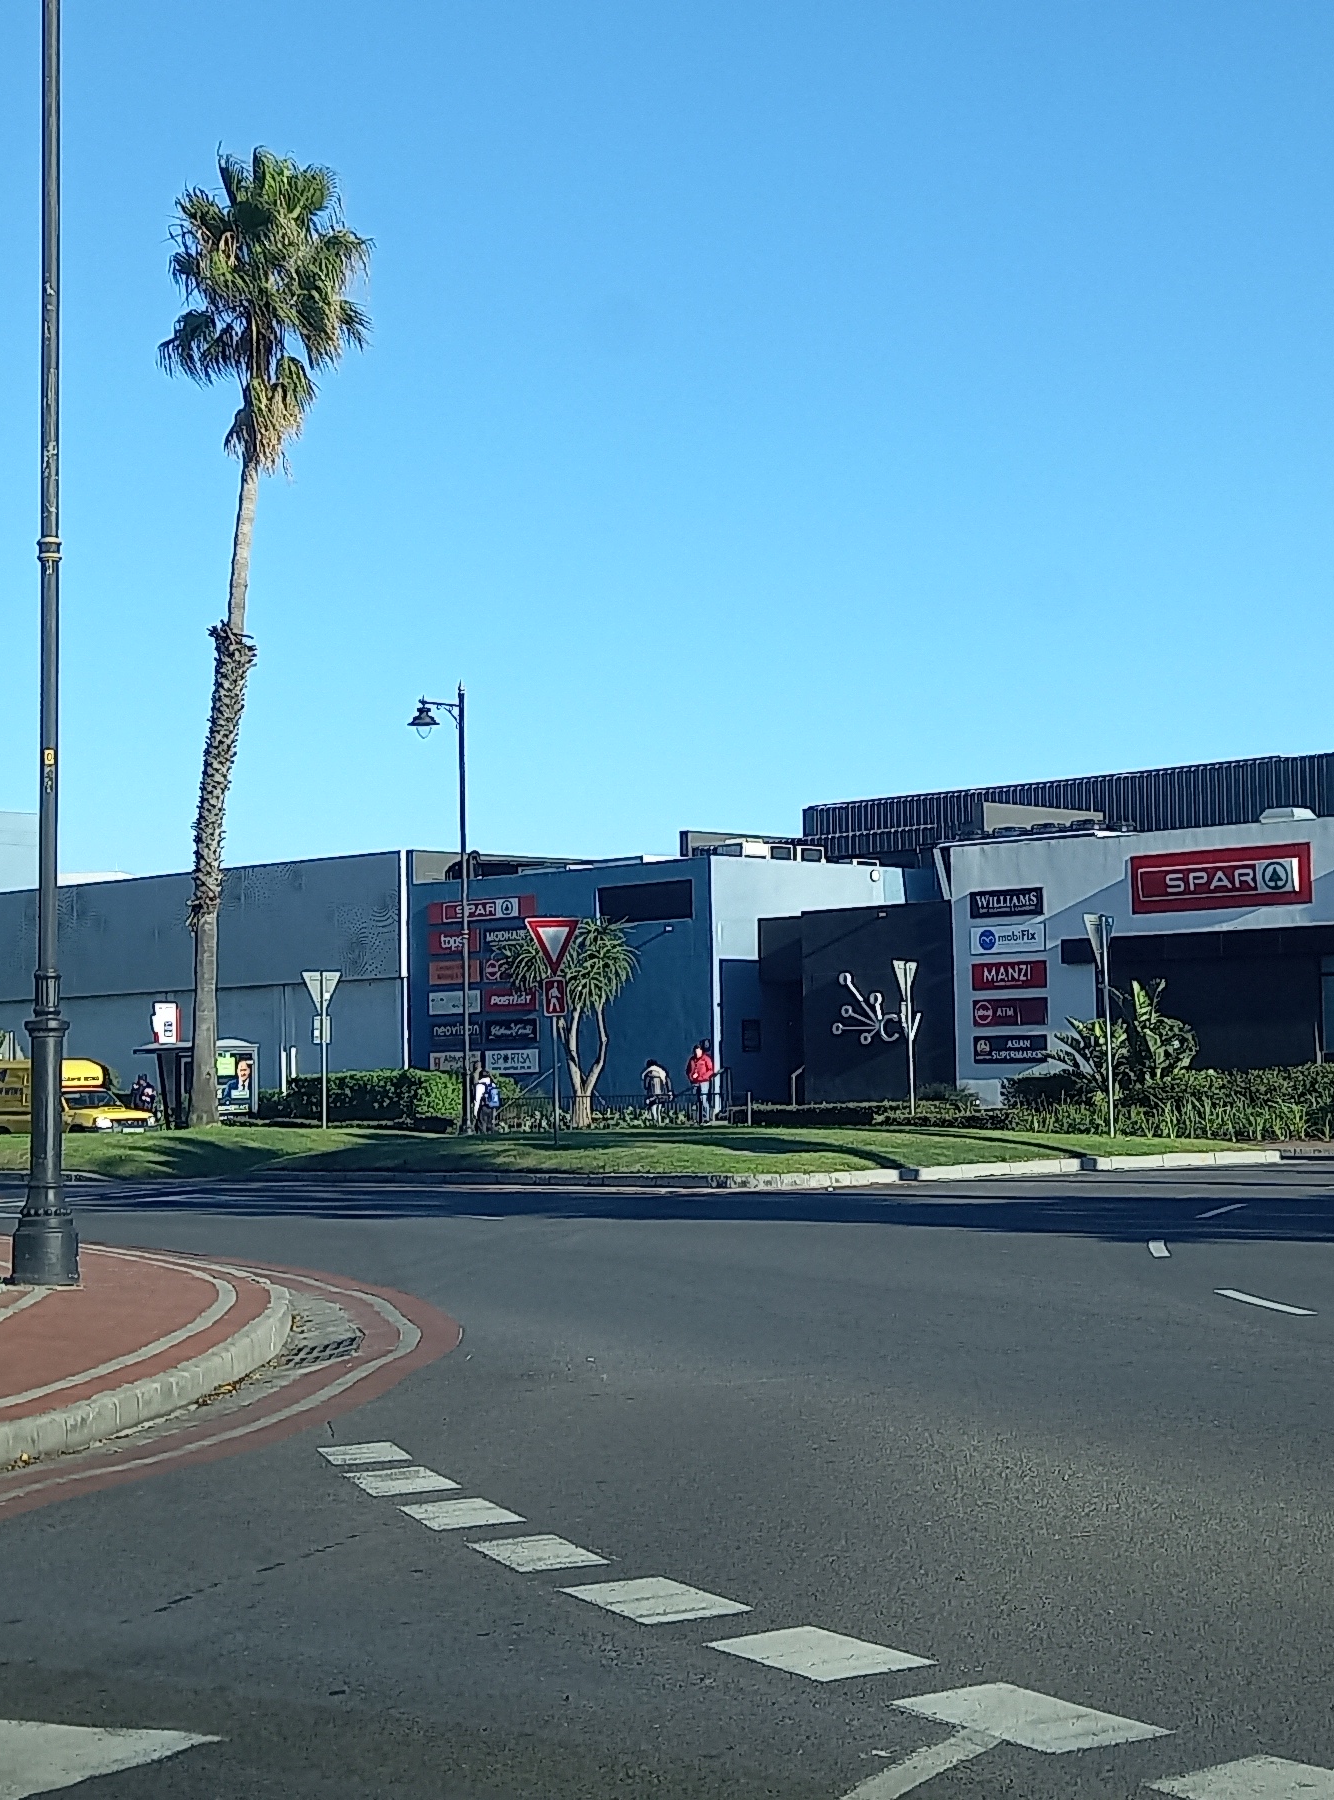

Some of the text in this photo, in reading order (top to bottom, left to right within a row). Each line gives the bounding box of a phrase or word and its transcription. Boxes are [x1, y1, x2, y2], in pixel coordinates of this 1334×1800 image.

[1165, 867, 1256, 893] SPAR
[975, 891, 1038, 908] WILLIAMS
[456, 904, 495, 918] SPAR
[983, 964, 1031, 982] MANZI
[996, 1007, 1014, 1017] ATM
[433, 1022, 479, 1036] neovison
